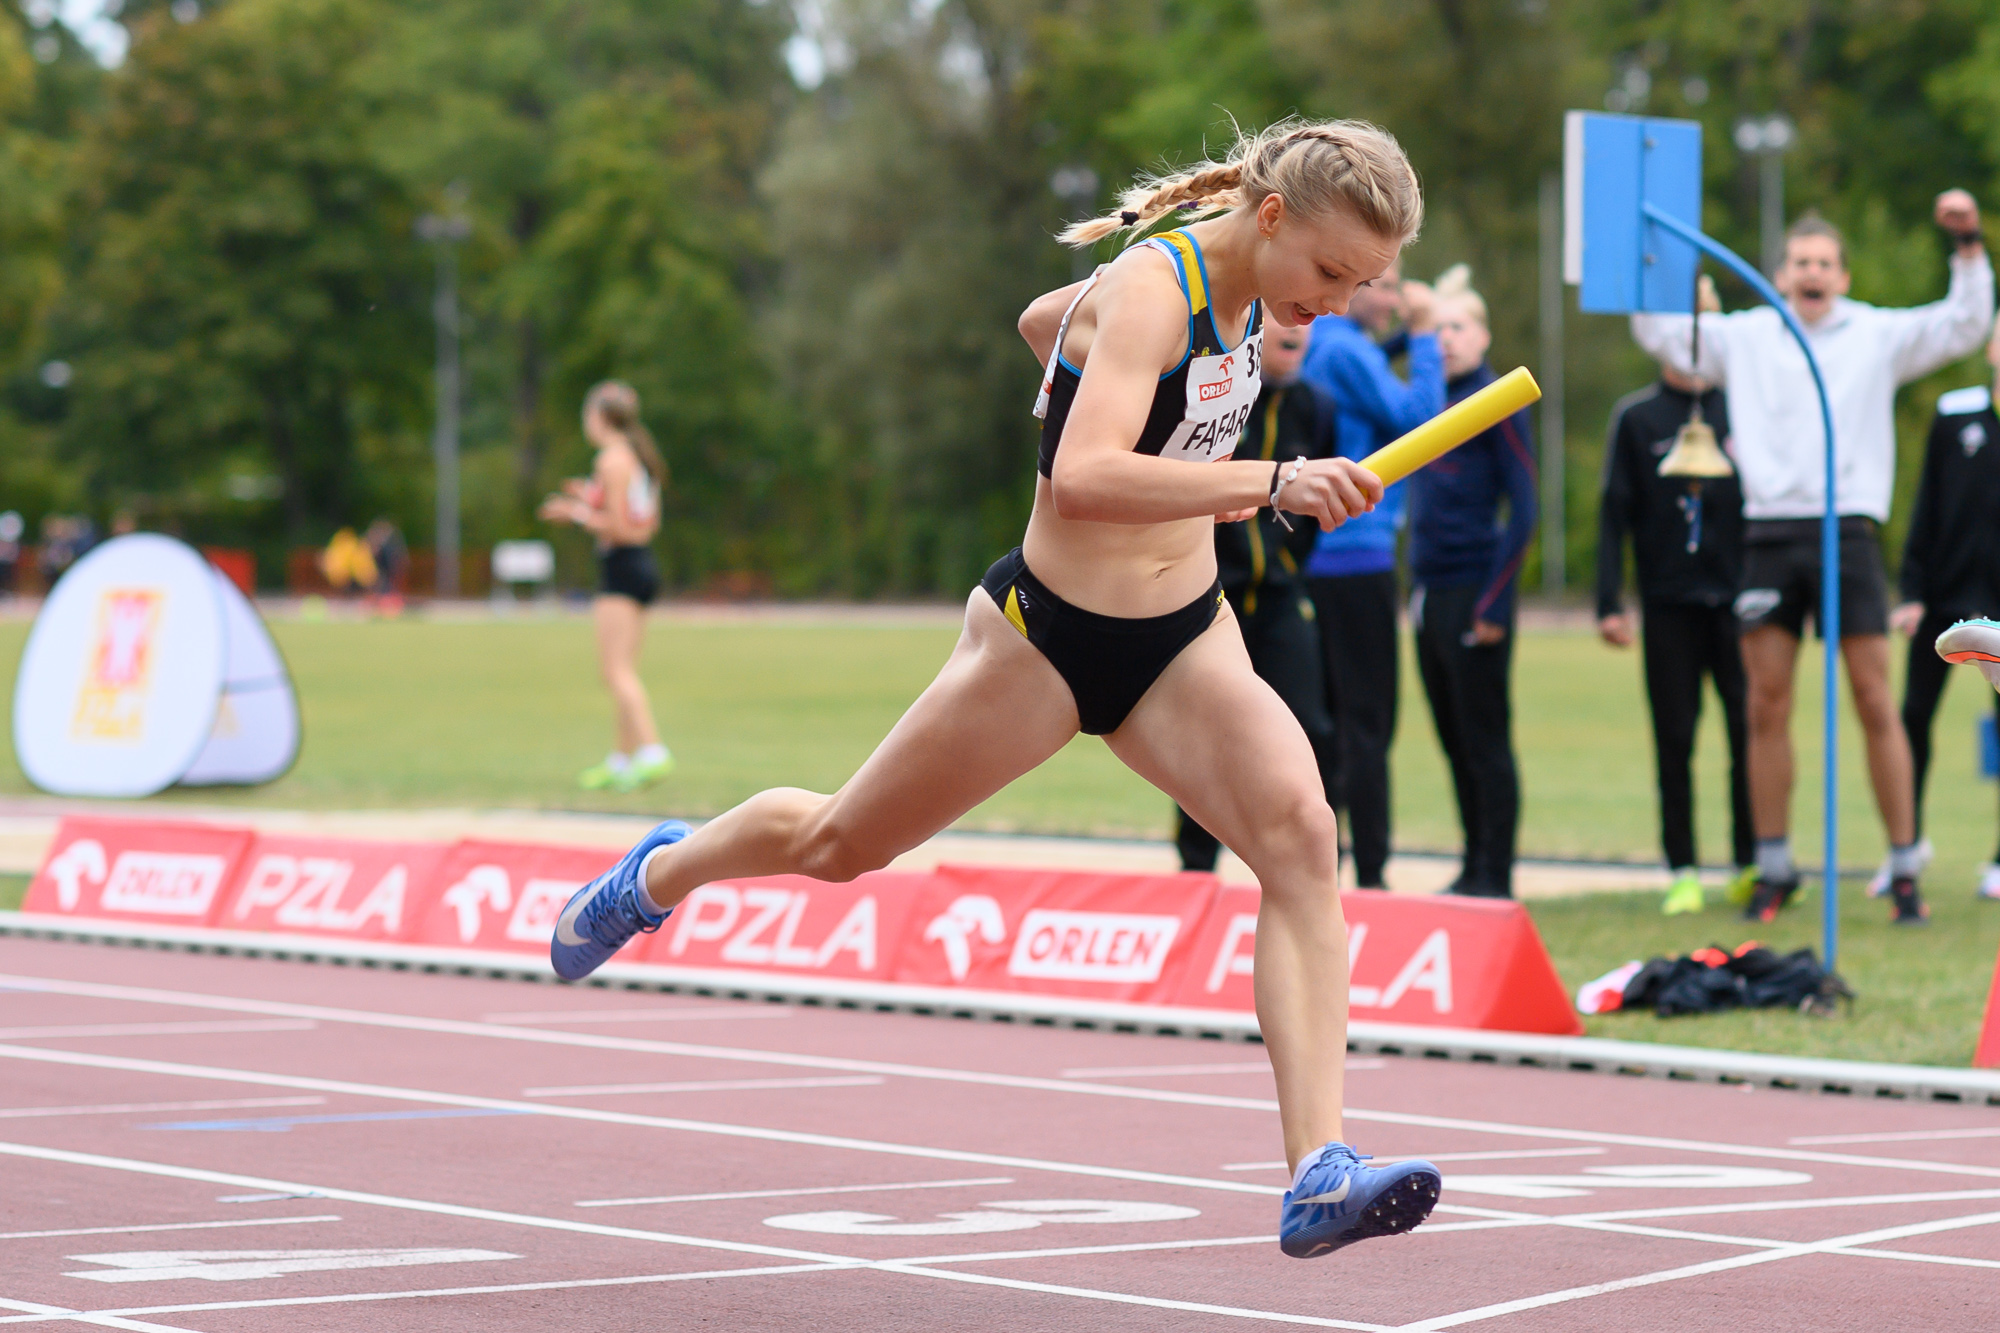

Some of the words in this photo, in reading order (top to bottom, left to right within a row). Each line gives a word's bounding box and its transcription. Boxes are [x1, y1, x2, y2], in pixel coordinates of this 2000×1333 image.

[1201, 380, 1230, 399] ORLEN
[1182, 397, 1256, 455] FĄFAR
[234, 855, 406, 934] PZLA
[669, 884, 878, 972] PZLA
[1029, 926, 1161, 967] ORLEN
[1205, 913, 1453, 1014] PLA
[762, 1199, 1202, 1236] 3
[60, 1248, 527, 1283] 4
